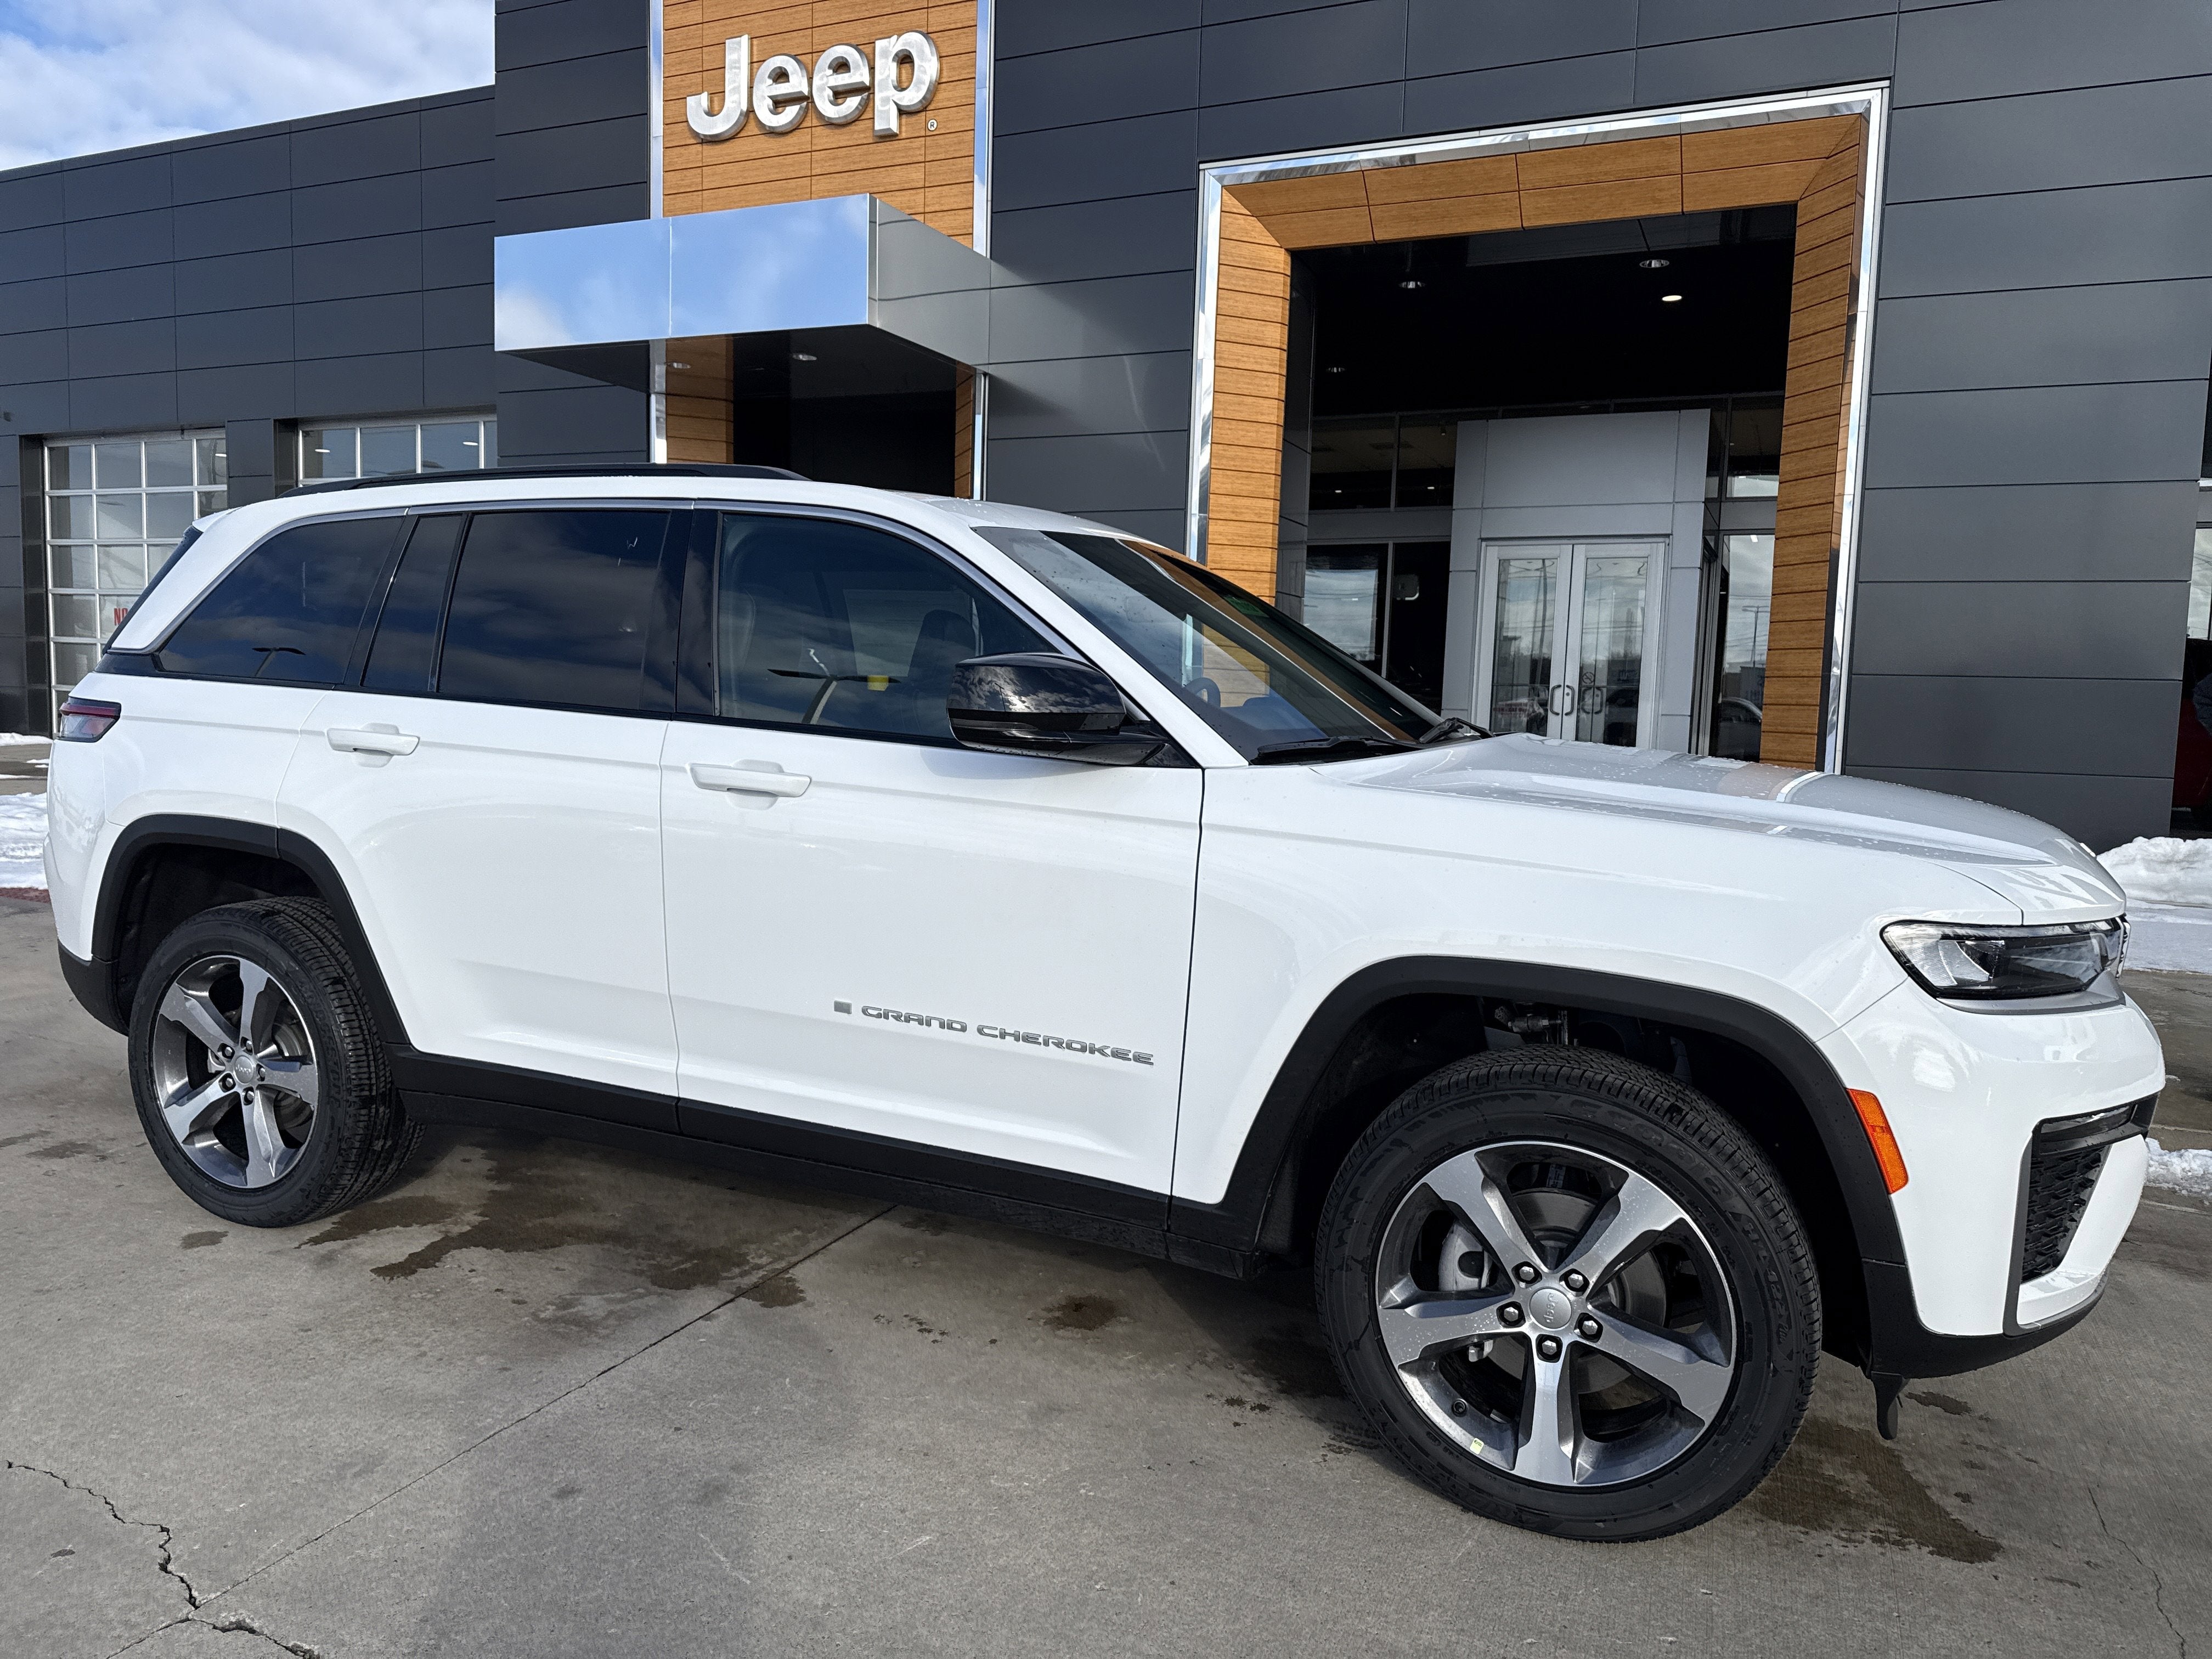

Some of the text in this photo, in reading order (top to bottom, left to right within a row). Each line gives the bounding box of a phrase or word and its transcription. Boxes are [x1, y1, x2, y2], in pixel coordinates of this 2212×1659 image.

[686, 30, 940, 141] Jeep
[862, 1006, 1154, 1065] GRAND CHEROKEE
[1543, 1293, 1559, 1323] Jeep
